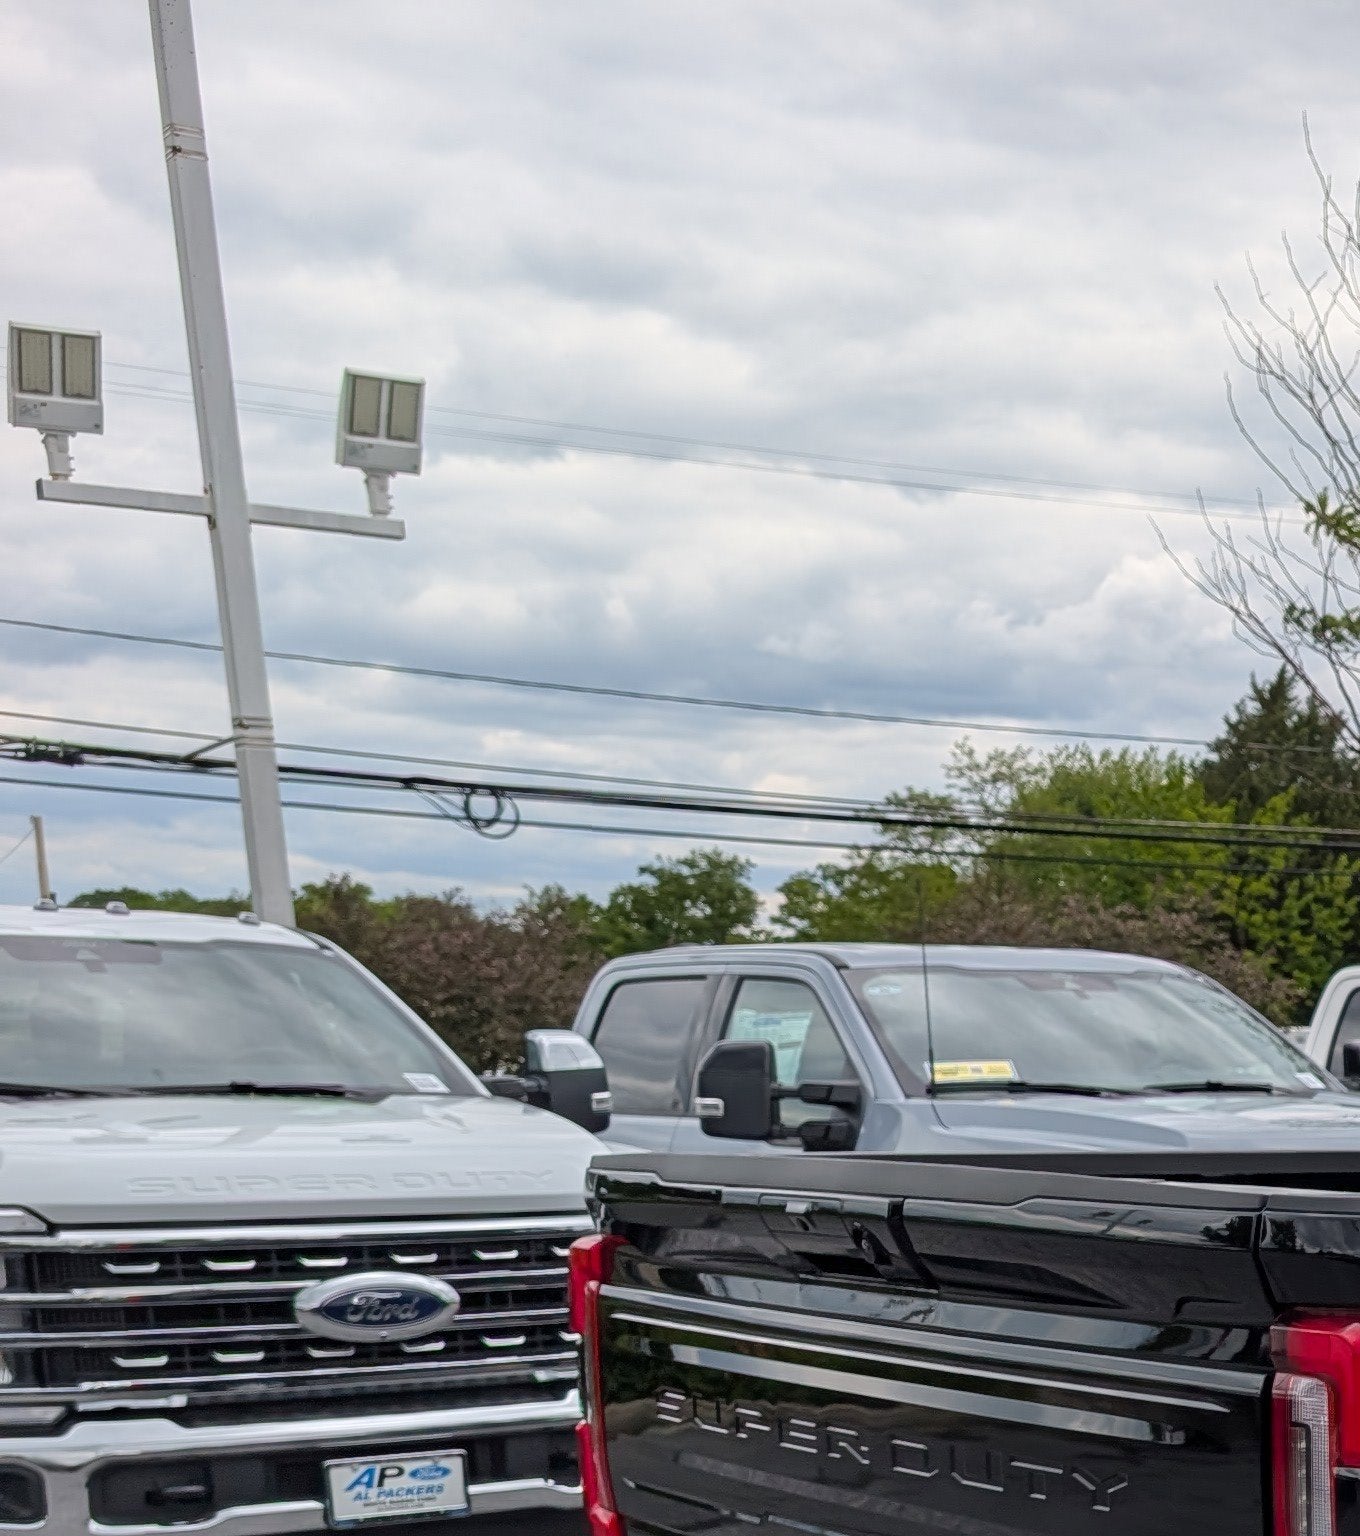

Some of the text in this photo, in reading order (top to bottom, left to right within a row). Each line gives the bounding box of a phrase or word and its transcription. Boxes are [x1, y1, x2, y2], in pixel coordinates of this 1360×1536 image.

[127, 1169, 554, 1197] SUPER DUTY
[346, 1290, 420, 1322] Ford
[655, 1385, 1130, 1512] SUPER DUTY
[344, 1464, 405, 1492] AP
[353, 1490, 371, 1502] AL
[377, 1483, 444, 1499] PACKERS
